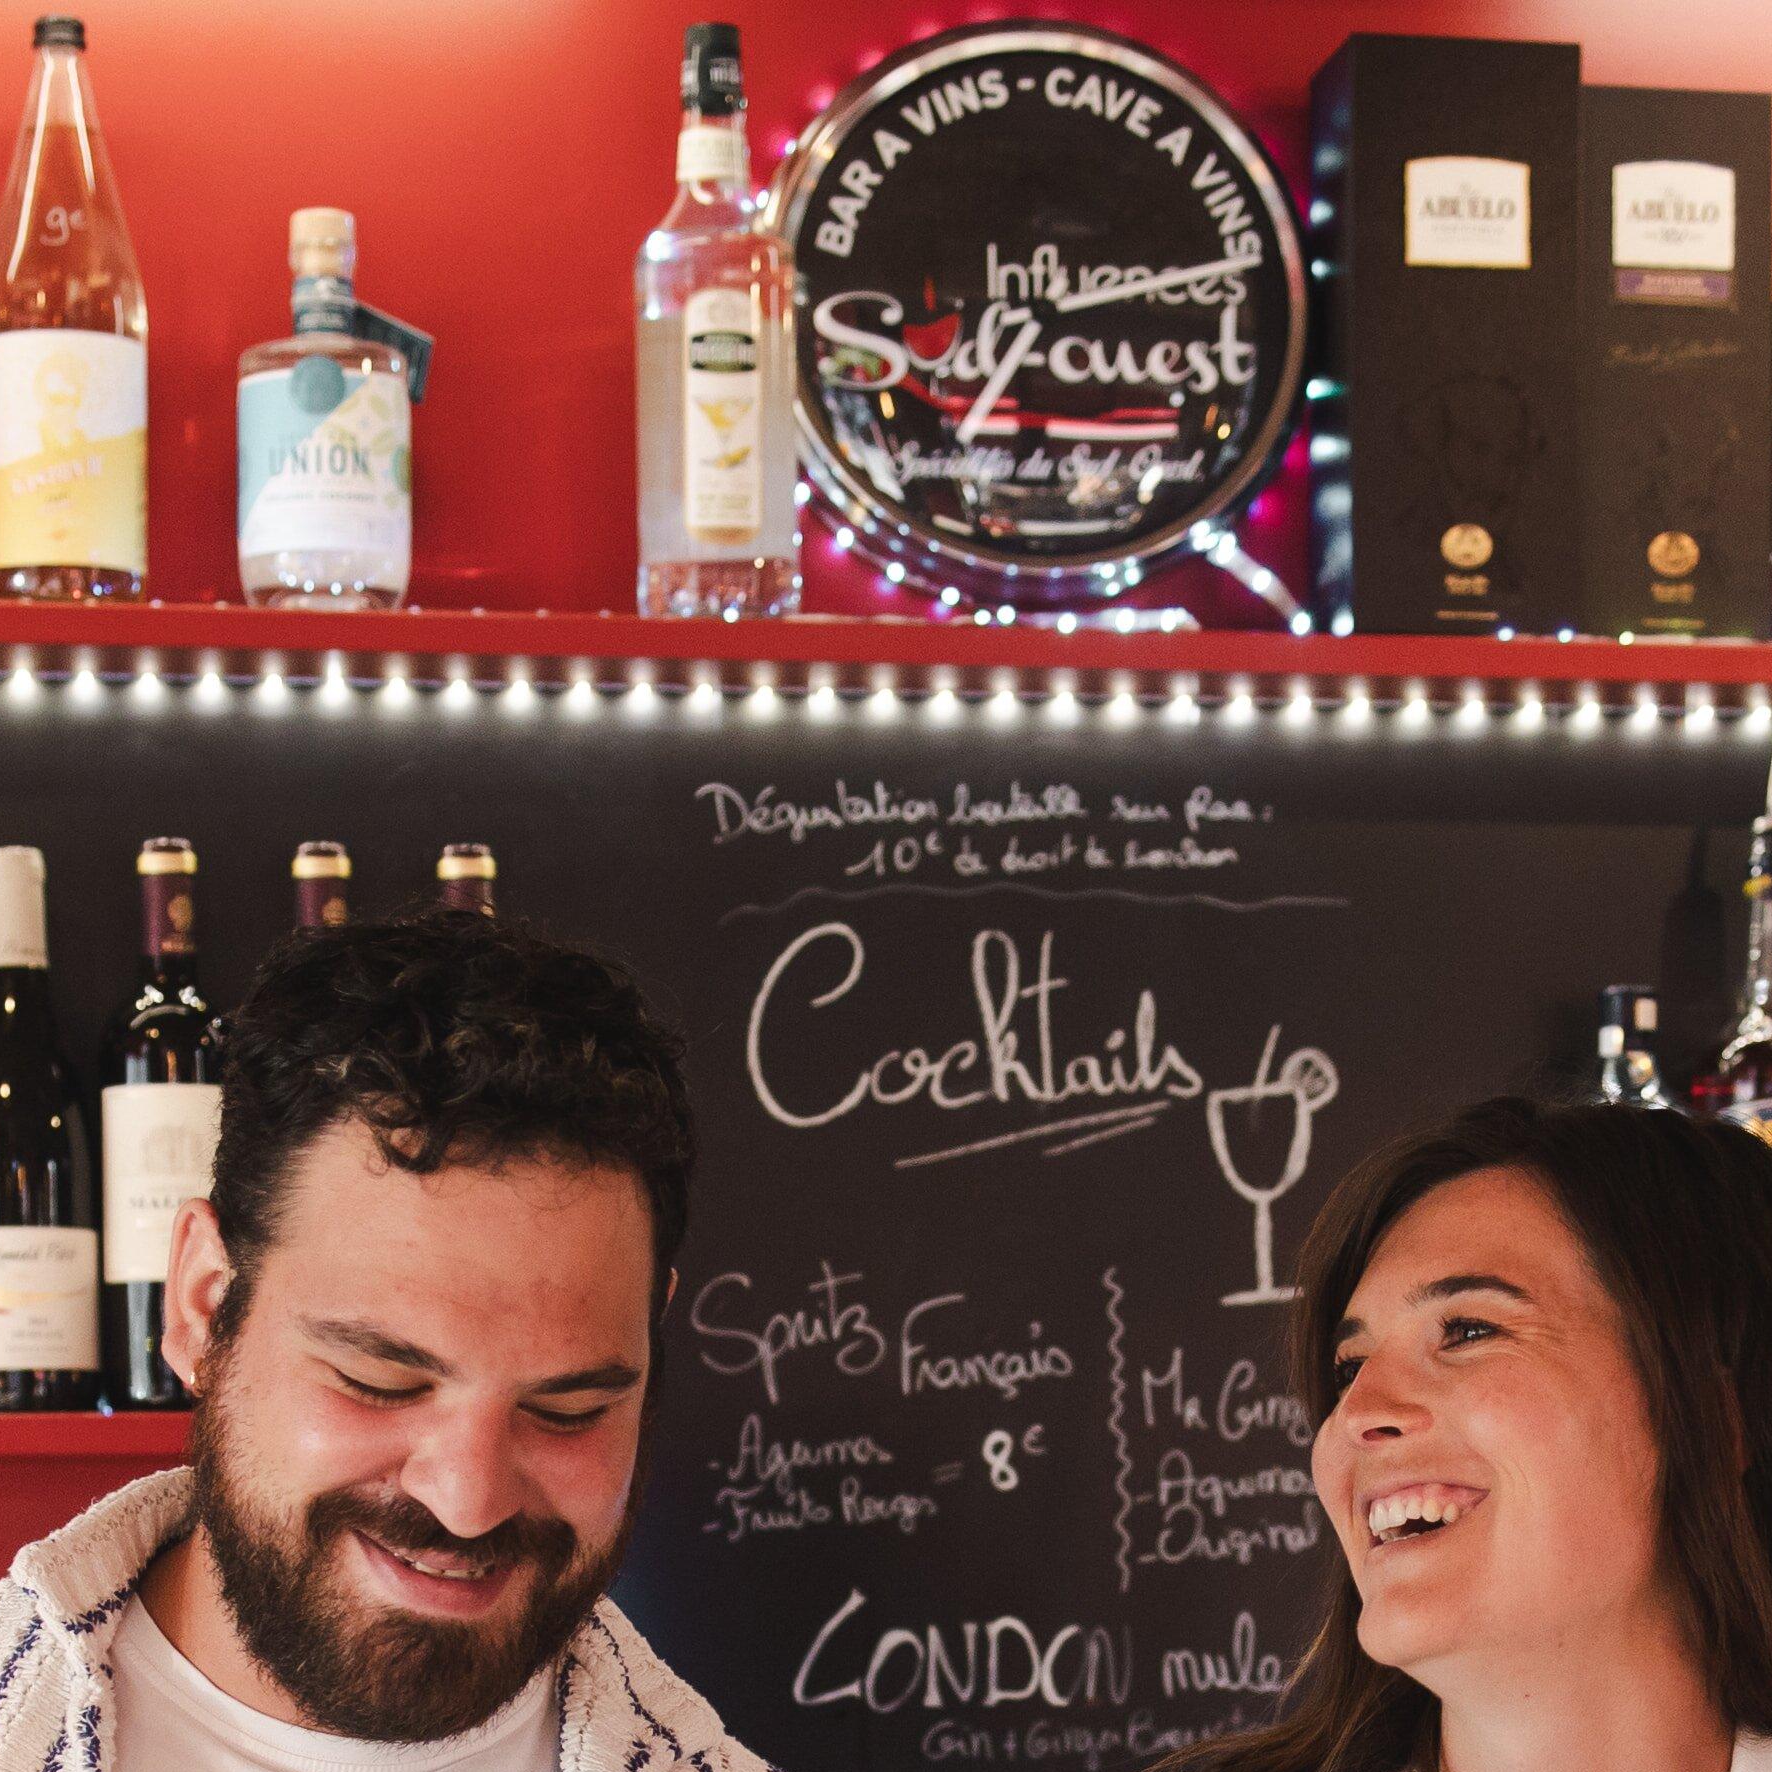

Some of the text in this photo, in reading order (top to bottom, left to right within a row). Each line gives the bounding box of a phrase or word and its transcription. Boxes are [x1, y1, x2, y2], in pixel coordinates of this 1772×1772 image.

[815, 156, 883, 257] BAR
[873, 127, 912, 171] A
[902, 69, 1010, 138] VINS
[1044, 67, 1164, 139] CAVE
[1155, 127, 1195, 167] A
[1190, 154, 1264, 262] VINS
[1418, 195, 1519, 222] ABUELO
[1625, 198, 1723, 224] ABUELO
[268, 443, 371, 476] UNION
[746, 921, 1205, 1129] Cocktails
[690, 1260, 887, 1407] Spritz
[900, 1292, 1075, 1398] Français
[792, 1588, 1286, 1712] LONDON mule
[921, 1718, 997, 1762] Gin
